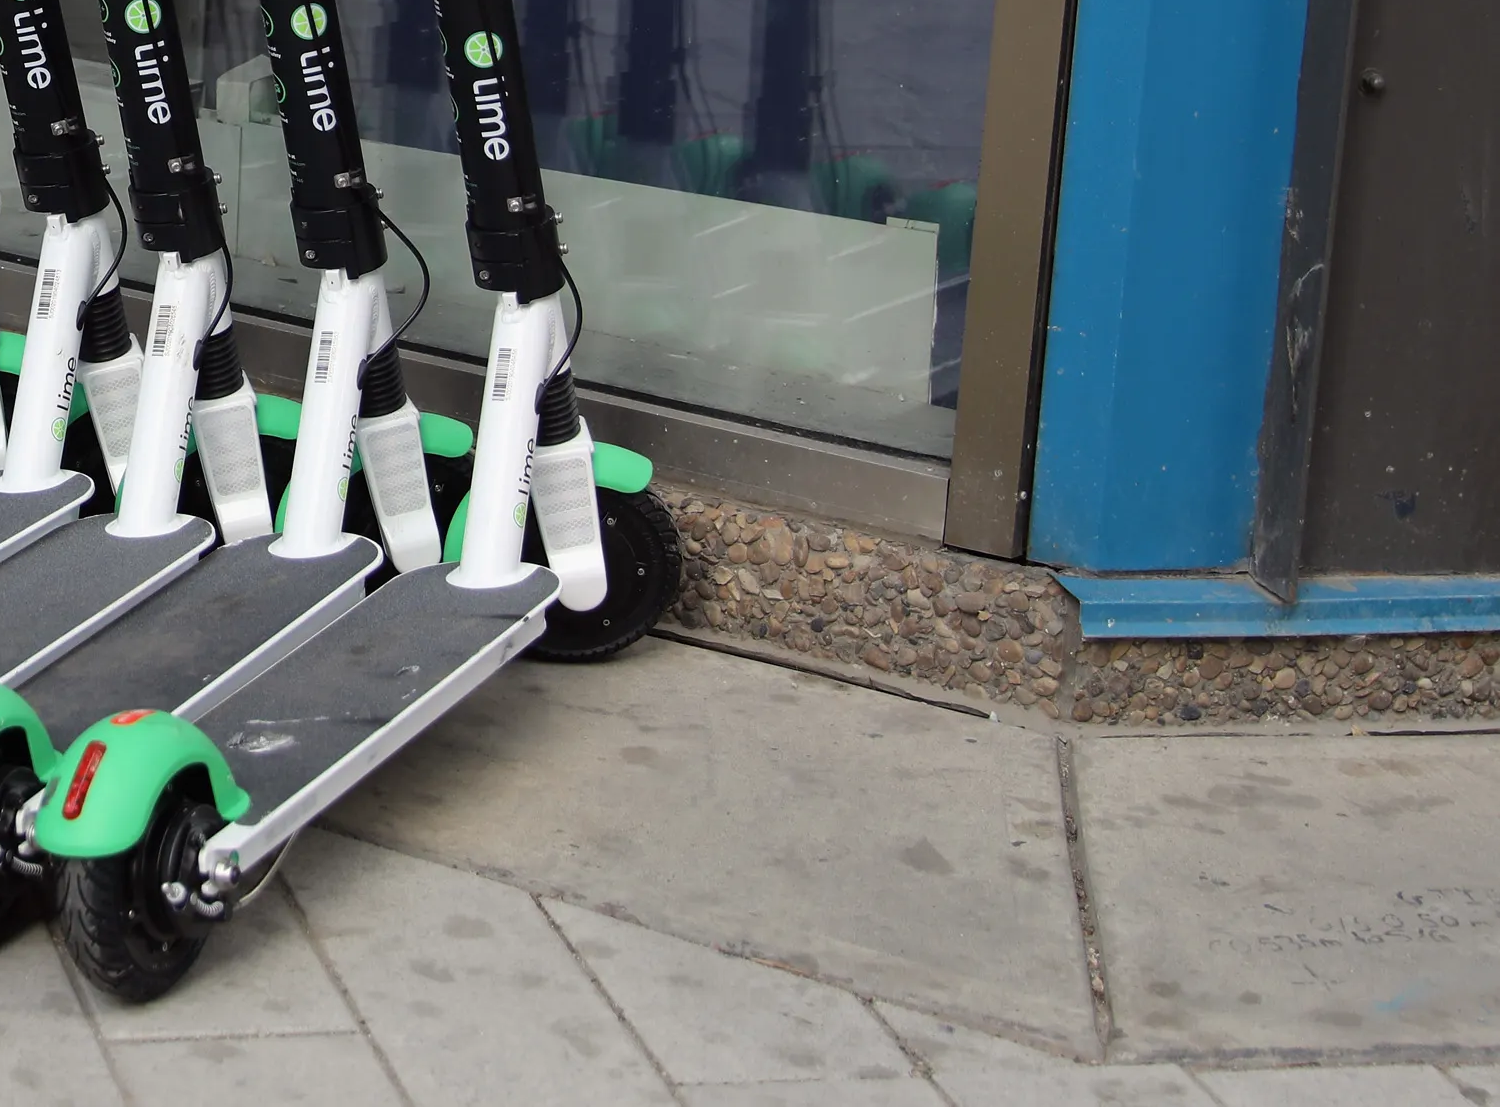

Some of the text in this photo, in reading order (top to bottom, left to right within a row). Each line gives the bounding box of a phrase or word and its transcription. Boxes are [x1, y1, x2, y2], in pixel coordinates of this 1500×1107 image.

[13, 7, 52, 90] Lime
[134, 39, 172, 125] Lime
[299, 45, 336, 132] Lime
[472, 75, 510, 161] Lime
[56, 358, 77, 412] Lime
